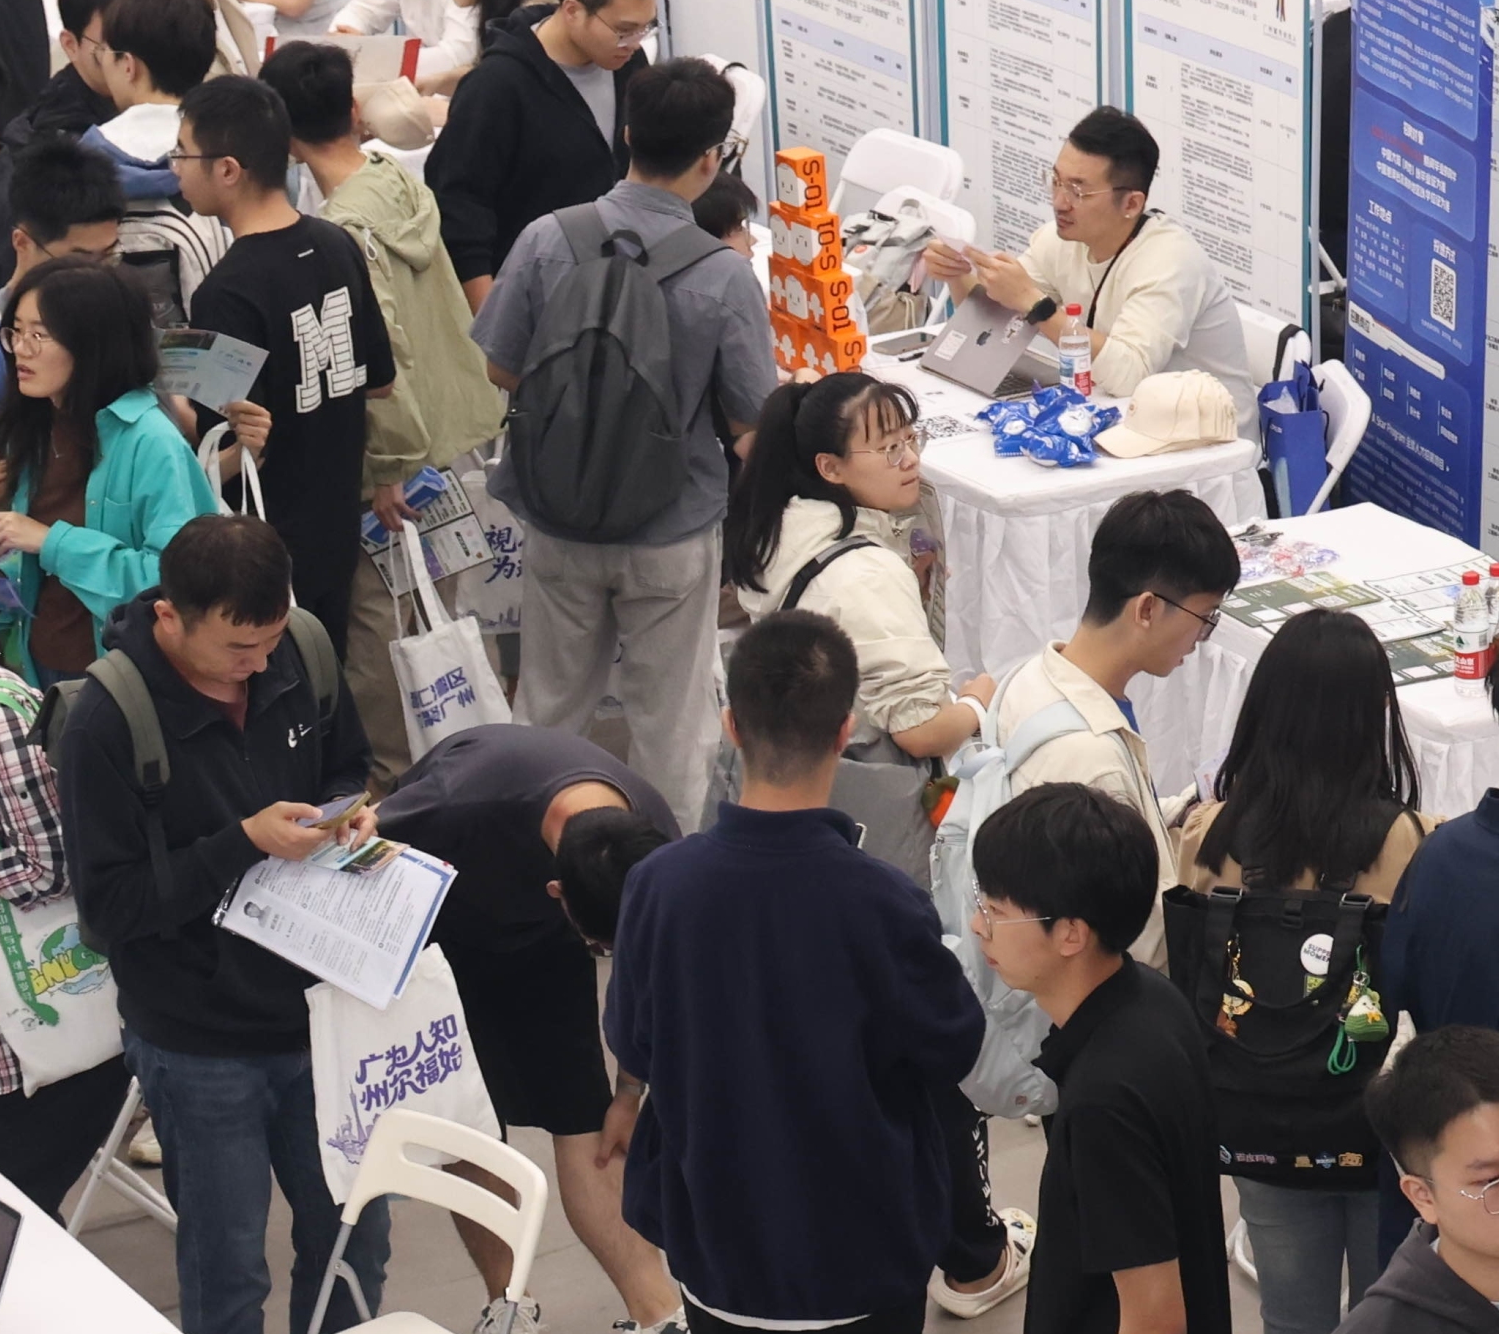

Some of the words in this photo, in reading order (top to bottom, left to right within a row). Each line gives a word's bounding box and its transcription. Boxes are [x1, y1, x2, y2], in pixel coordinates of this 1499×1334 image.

[802, 159, 824, 210] S-01
[818, 218, 838, 271] S-01
[831, 278, 849, 333] S-01
